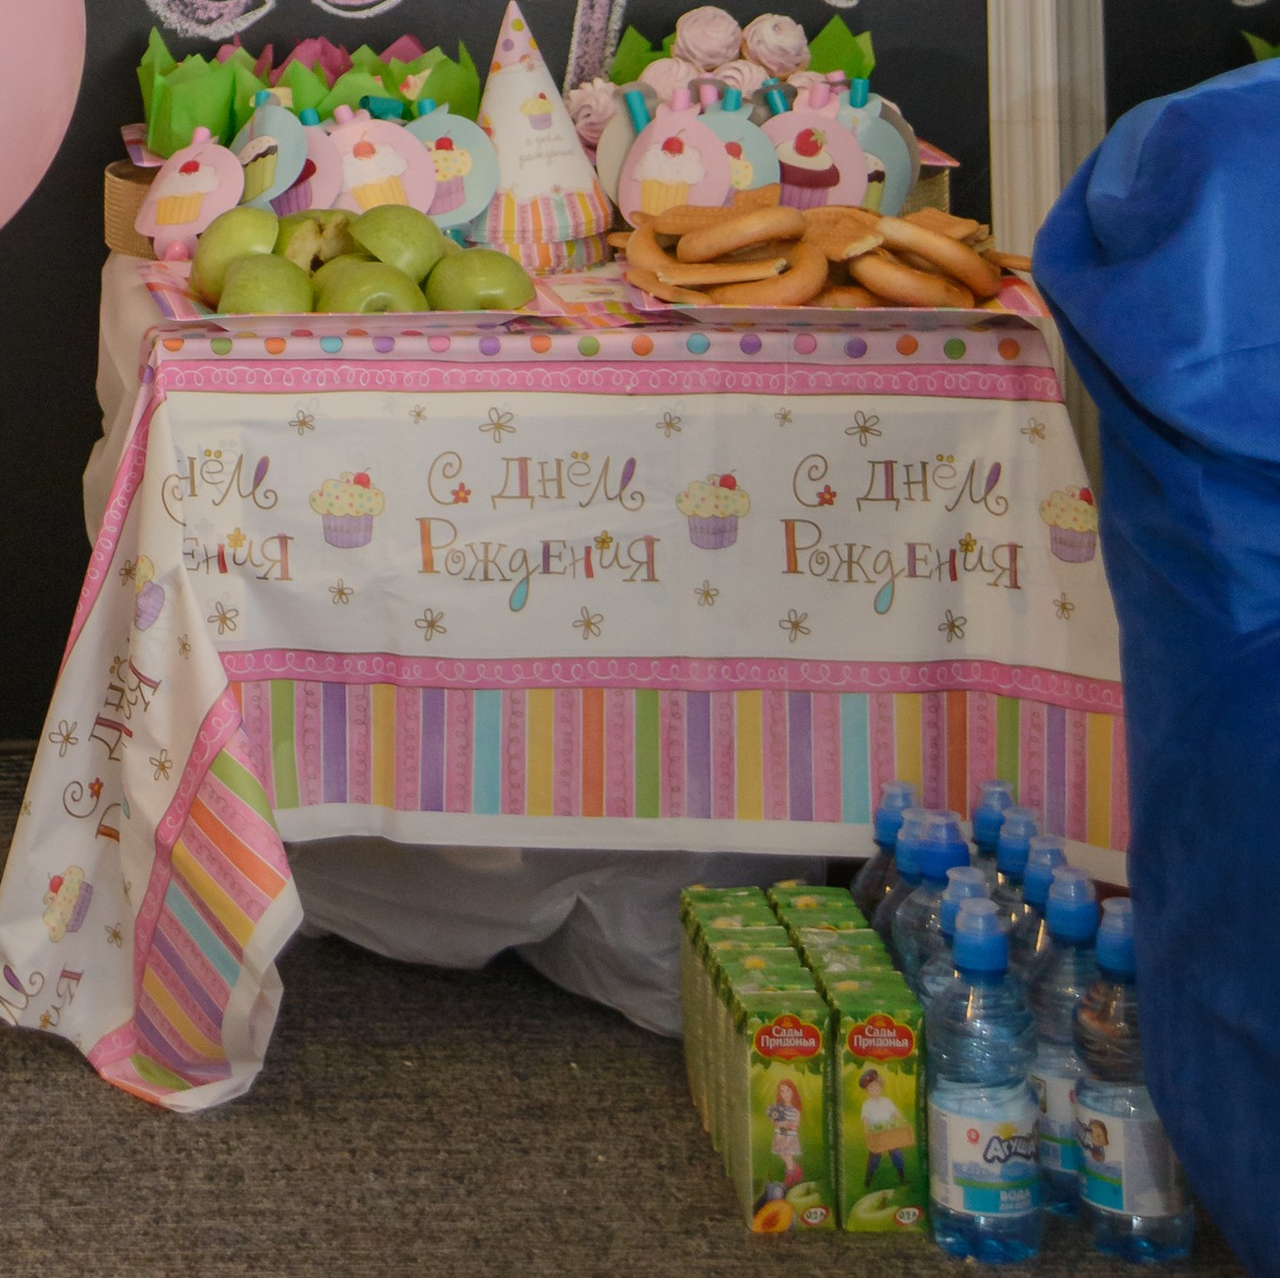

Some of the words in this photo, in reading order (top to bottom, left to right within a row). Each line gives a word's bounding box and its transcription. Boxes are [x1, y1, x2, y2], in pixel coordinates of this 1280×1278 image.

[771, 1025, 803, 1038] Сады
[864, 1025, 896, 1038] Сады
[761, 1036, 815, 1049] Придонья
[853, 1036, 908, 1049] Придонья
